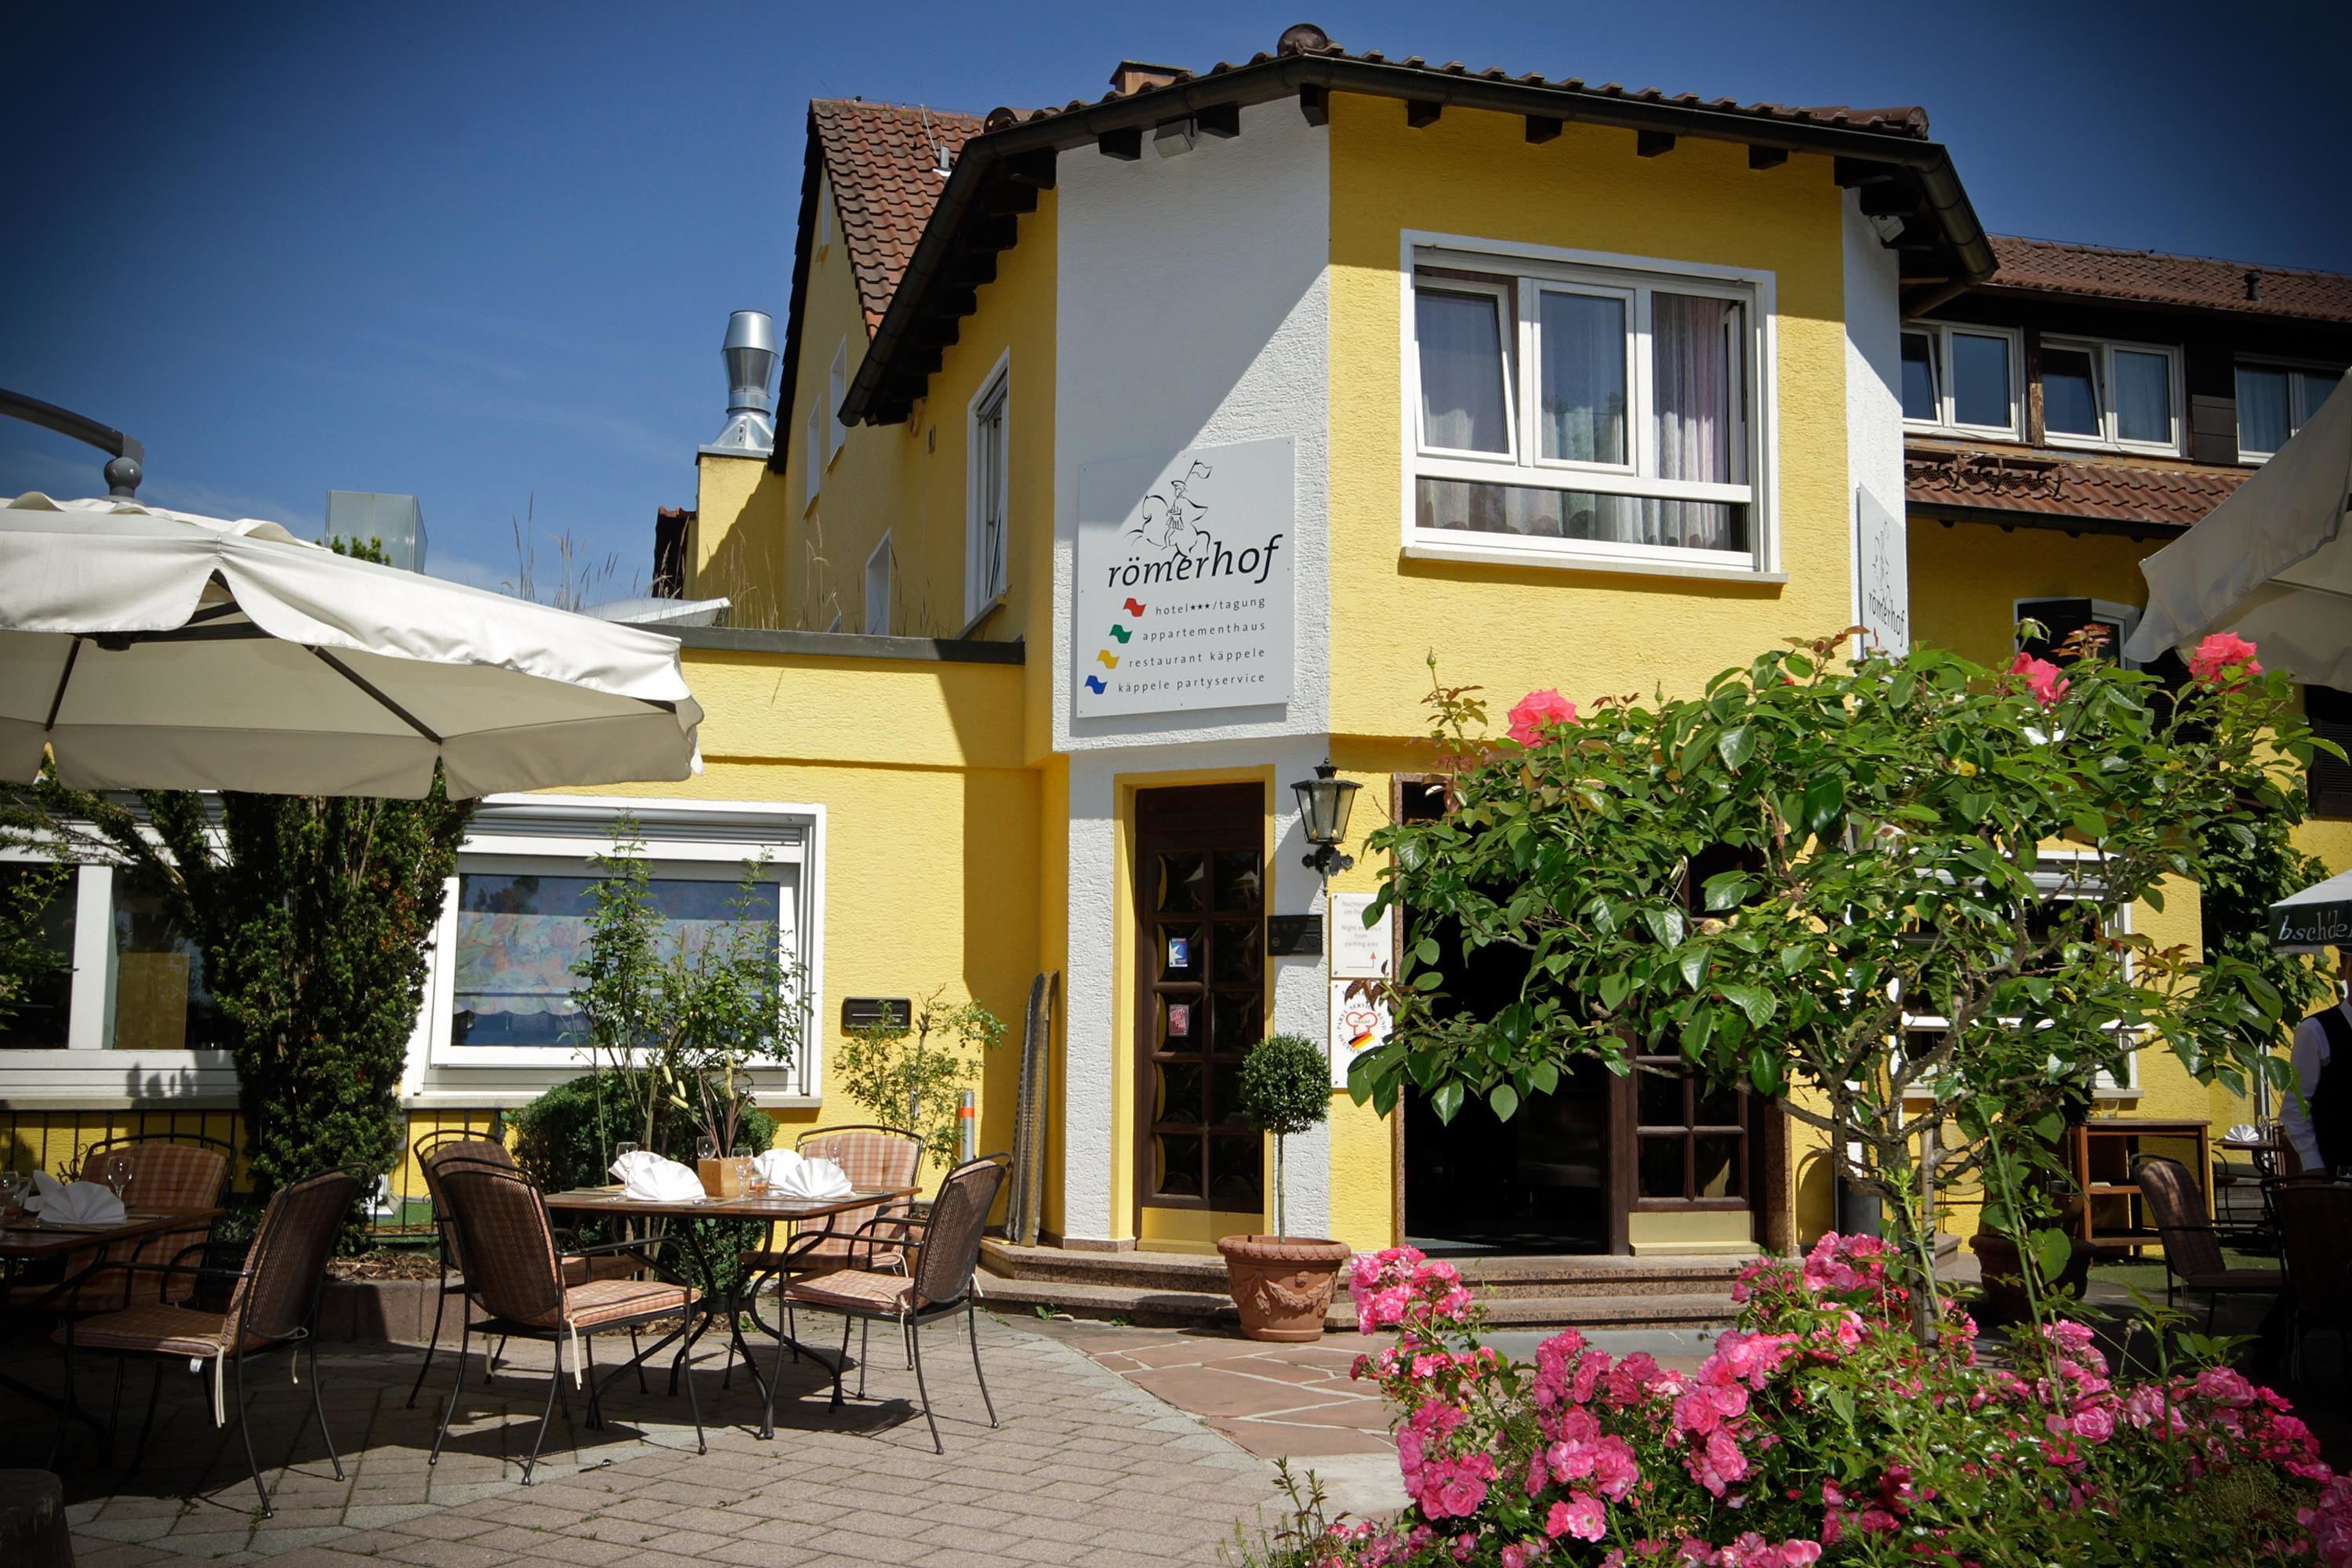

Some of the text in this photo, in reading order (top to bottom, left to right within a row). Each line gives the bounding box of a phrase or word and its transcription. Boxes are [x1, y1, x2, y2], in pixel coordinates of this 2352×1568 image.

[1108, 533, 1283, 588] römerhof
[1868, 589, 1905, 648] römerhof
[1142, 621, 1265, 642] appartementhaus
[1129, 648, 1265, 668] restaurant käppele
[1118, 672, 1265, 694] käppele partyservice
